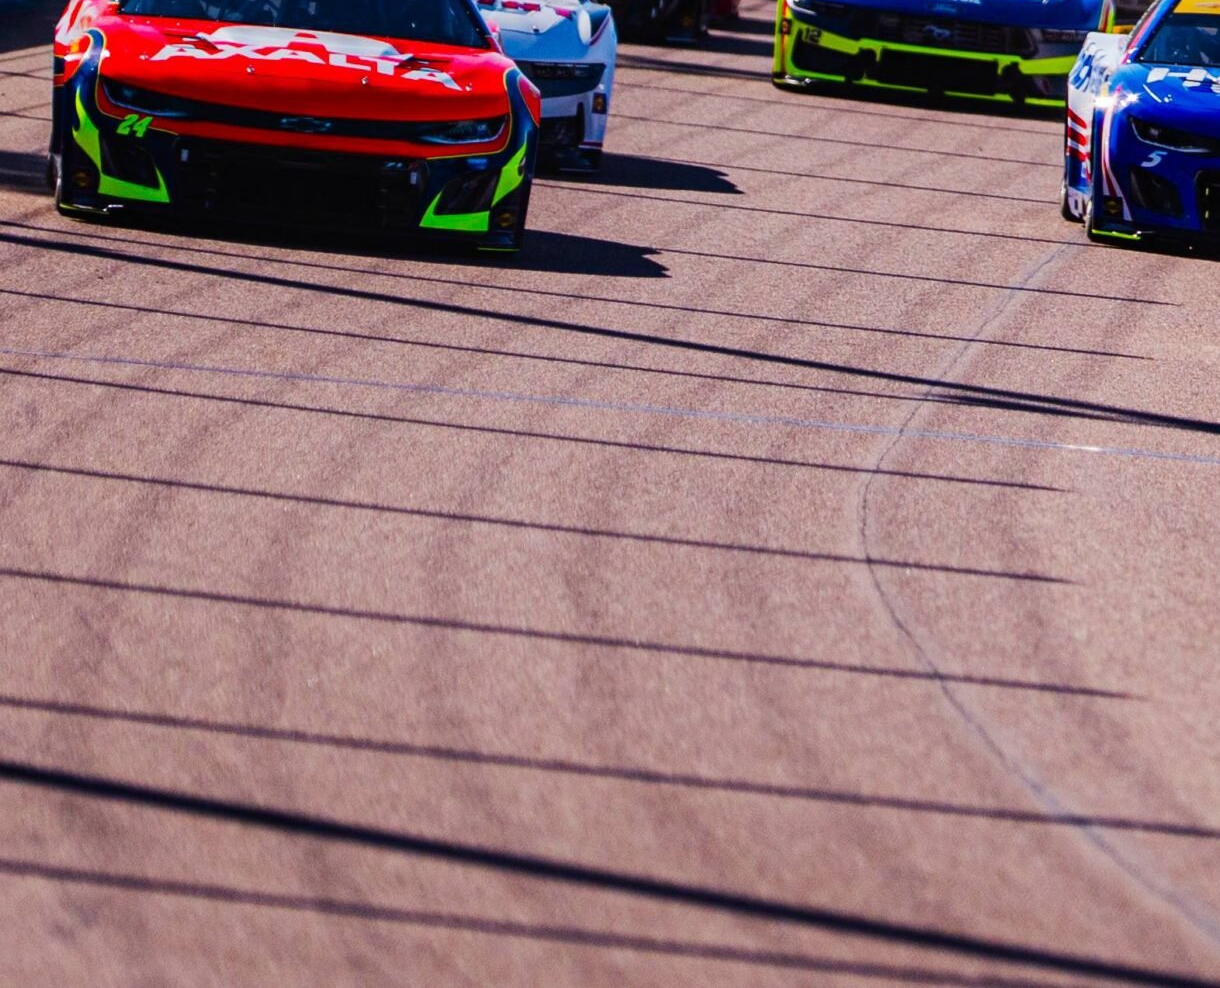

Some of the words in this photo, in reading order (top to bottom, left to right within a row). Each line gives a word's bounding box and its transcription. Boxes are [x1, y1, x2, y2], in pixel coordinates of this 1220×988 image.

[801, 25, 822, 44] 12
[149, 43, 464, 92] AXALTA
[115, 113, 154, 139] 24
[1140, 150, 1169, 168] 5
